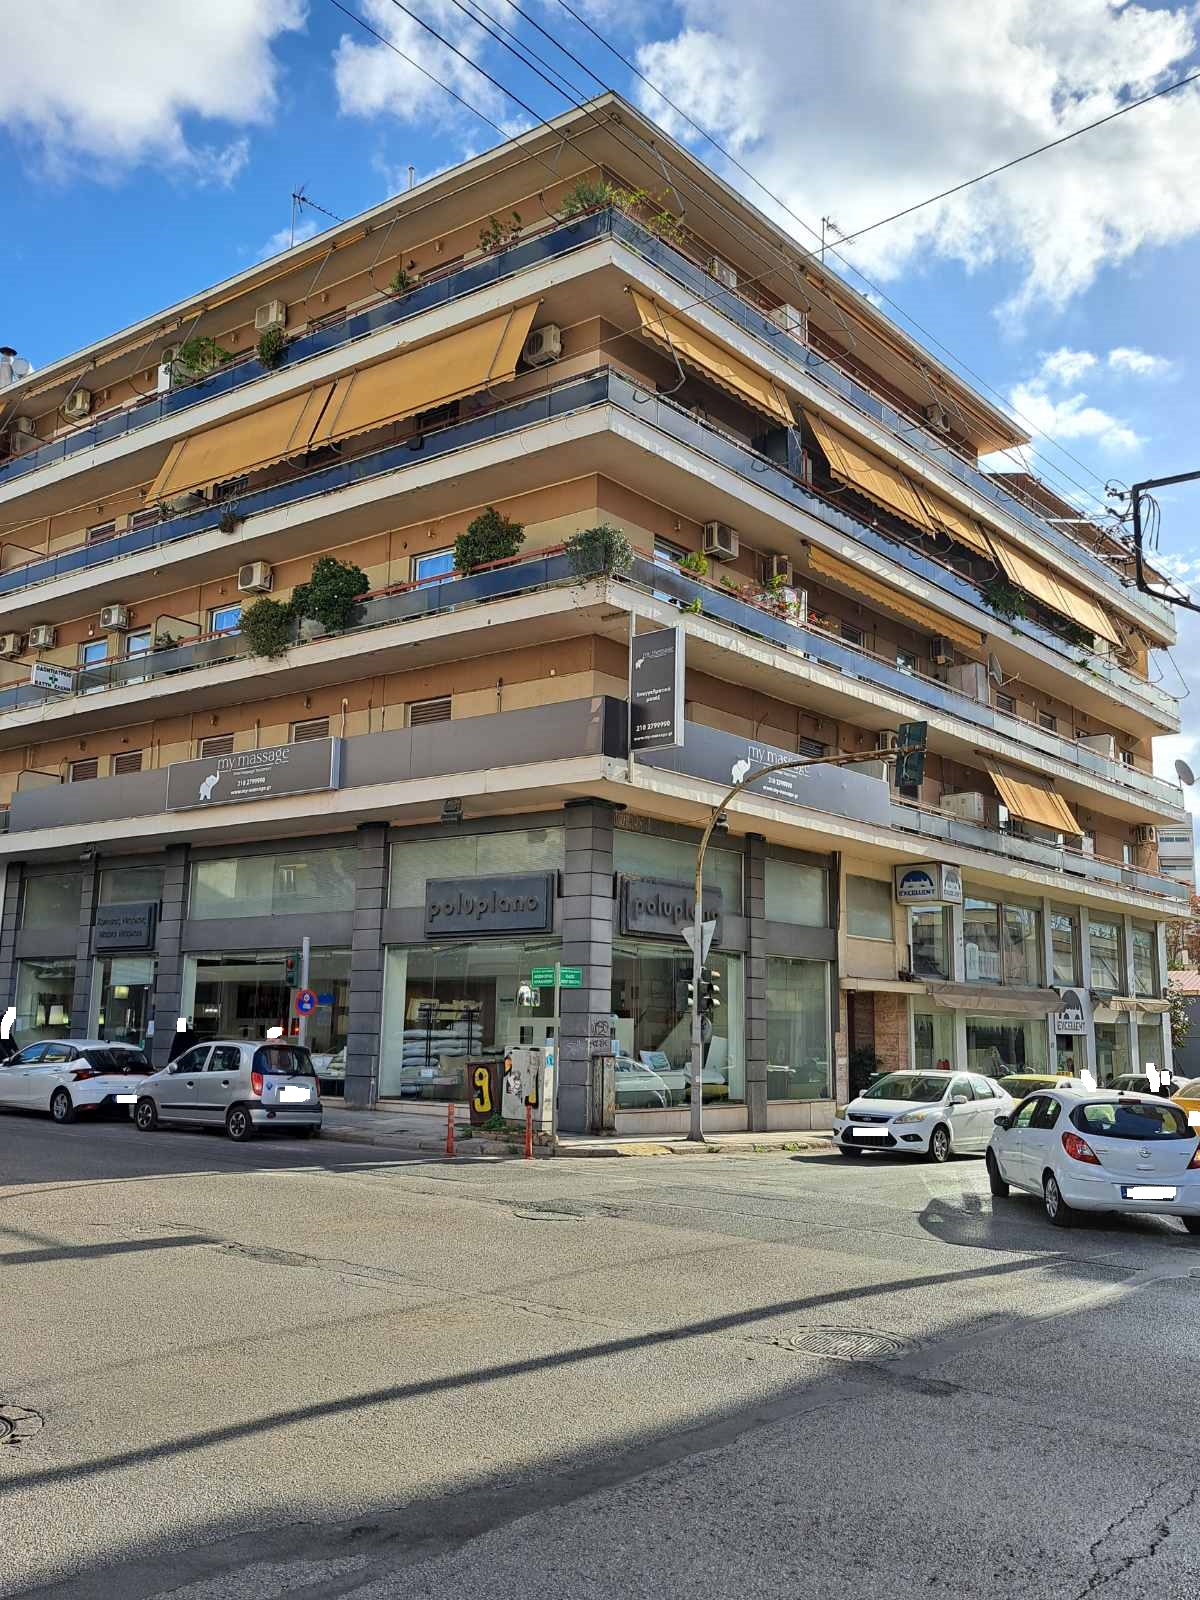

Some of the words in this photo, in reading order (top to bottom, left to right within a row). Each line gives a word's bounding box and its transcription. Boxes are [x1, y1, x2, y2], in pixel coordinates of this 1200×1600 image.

[217, 758, 235, 771] my
[238, 747, 290, 767] massage
[748, 746, 766, 763] my
[767, 751, 810, 777] masge
[428, 889, 538, 923] poluplano
[898, 888, 936, 897] EXCELLENT
